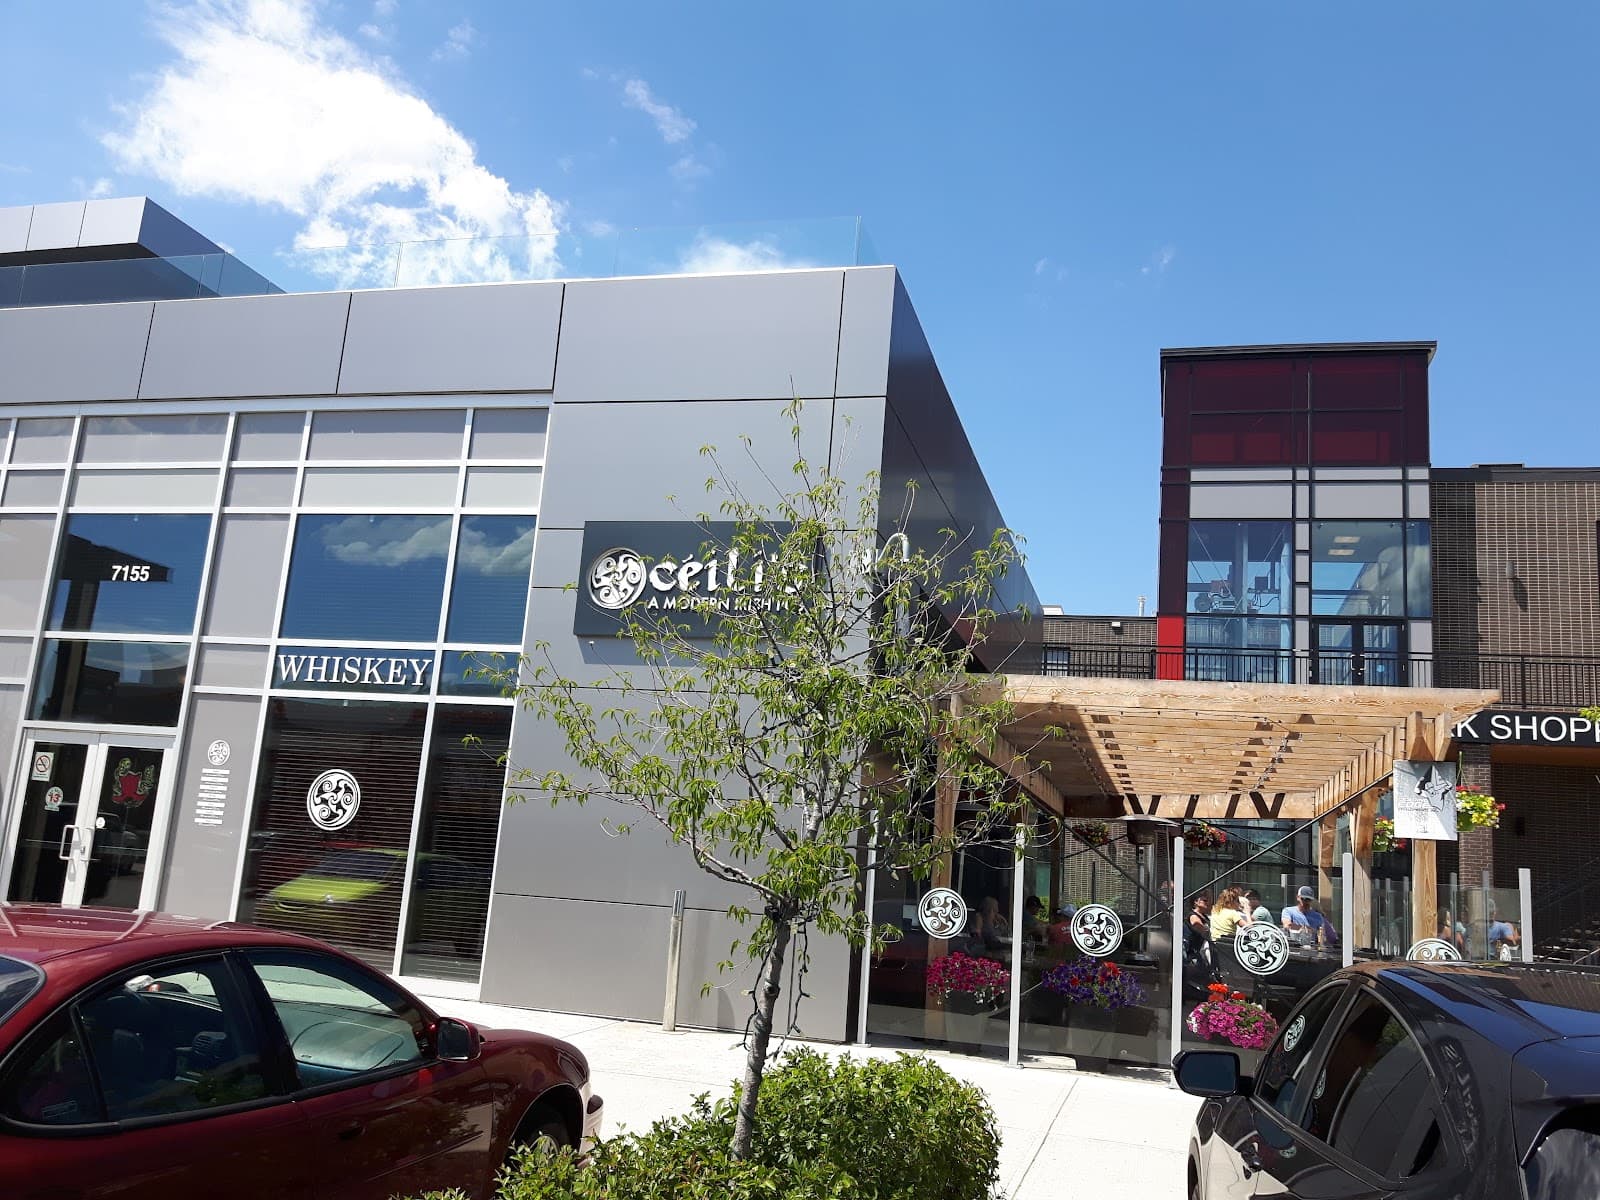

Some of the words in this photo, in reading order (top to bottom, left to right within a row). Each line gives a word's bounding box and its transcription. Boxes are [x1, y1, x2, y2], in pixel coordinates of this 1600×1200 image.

[111, 565, 150, 582] 7155
[647, 596, 659, 609] A
[278, 654, 432, 686] WHISKEY
